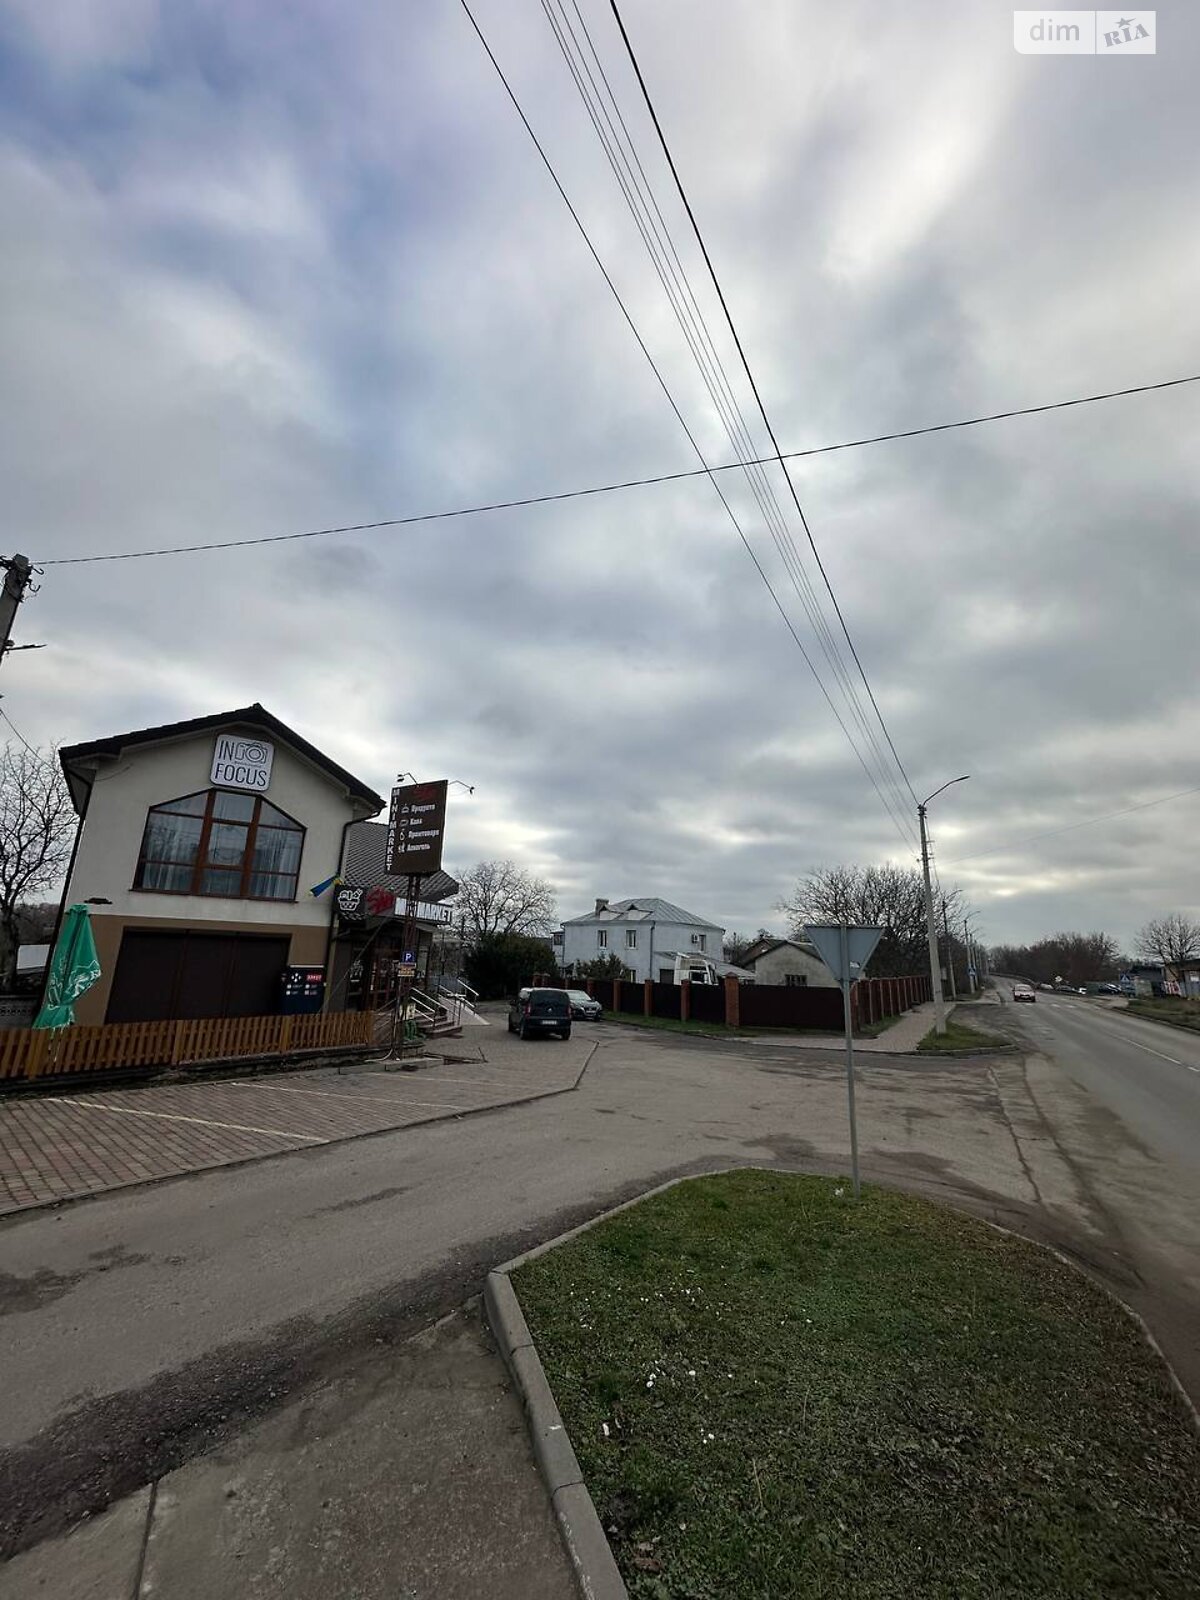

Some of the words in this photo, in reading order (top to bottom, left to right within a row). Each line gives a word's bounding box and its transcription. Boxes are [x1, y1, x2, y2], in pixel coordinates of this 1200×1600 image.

[218, 739, 235, 761] IN
[214, 762, 267, 787] FOCUS
[417, 902, 451, 922] MARKET
[405, 952, 412, 962] P
